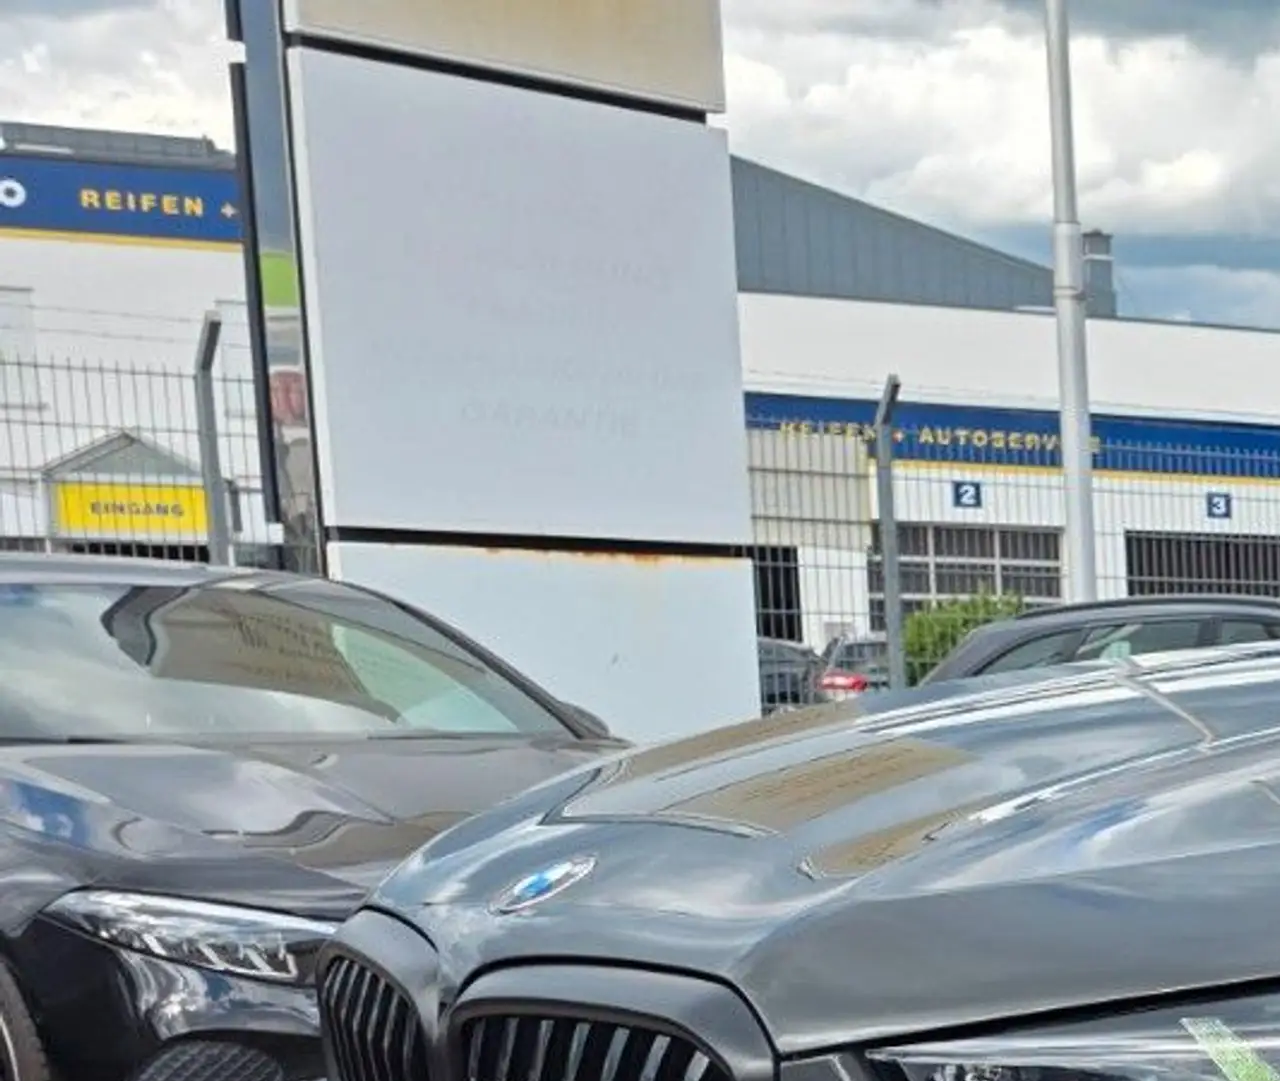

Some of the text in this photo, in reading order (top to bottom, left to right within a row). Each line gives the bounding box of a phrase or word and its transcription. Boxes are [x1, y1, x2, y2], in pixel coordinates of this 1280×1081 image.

[79, 188, 204, 217] REIFEN
[779, 421, 877, 441] REIFEN
[919, 425, 1101, 453] AUTOSERVE
[959, 484, 977, 505] 2
[90, 502, 184, 516] EINGANG
[1212, 497, 1227, 515] 3
